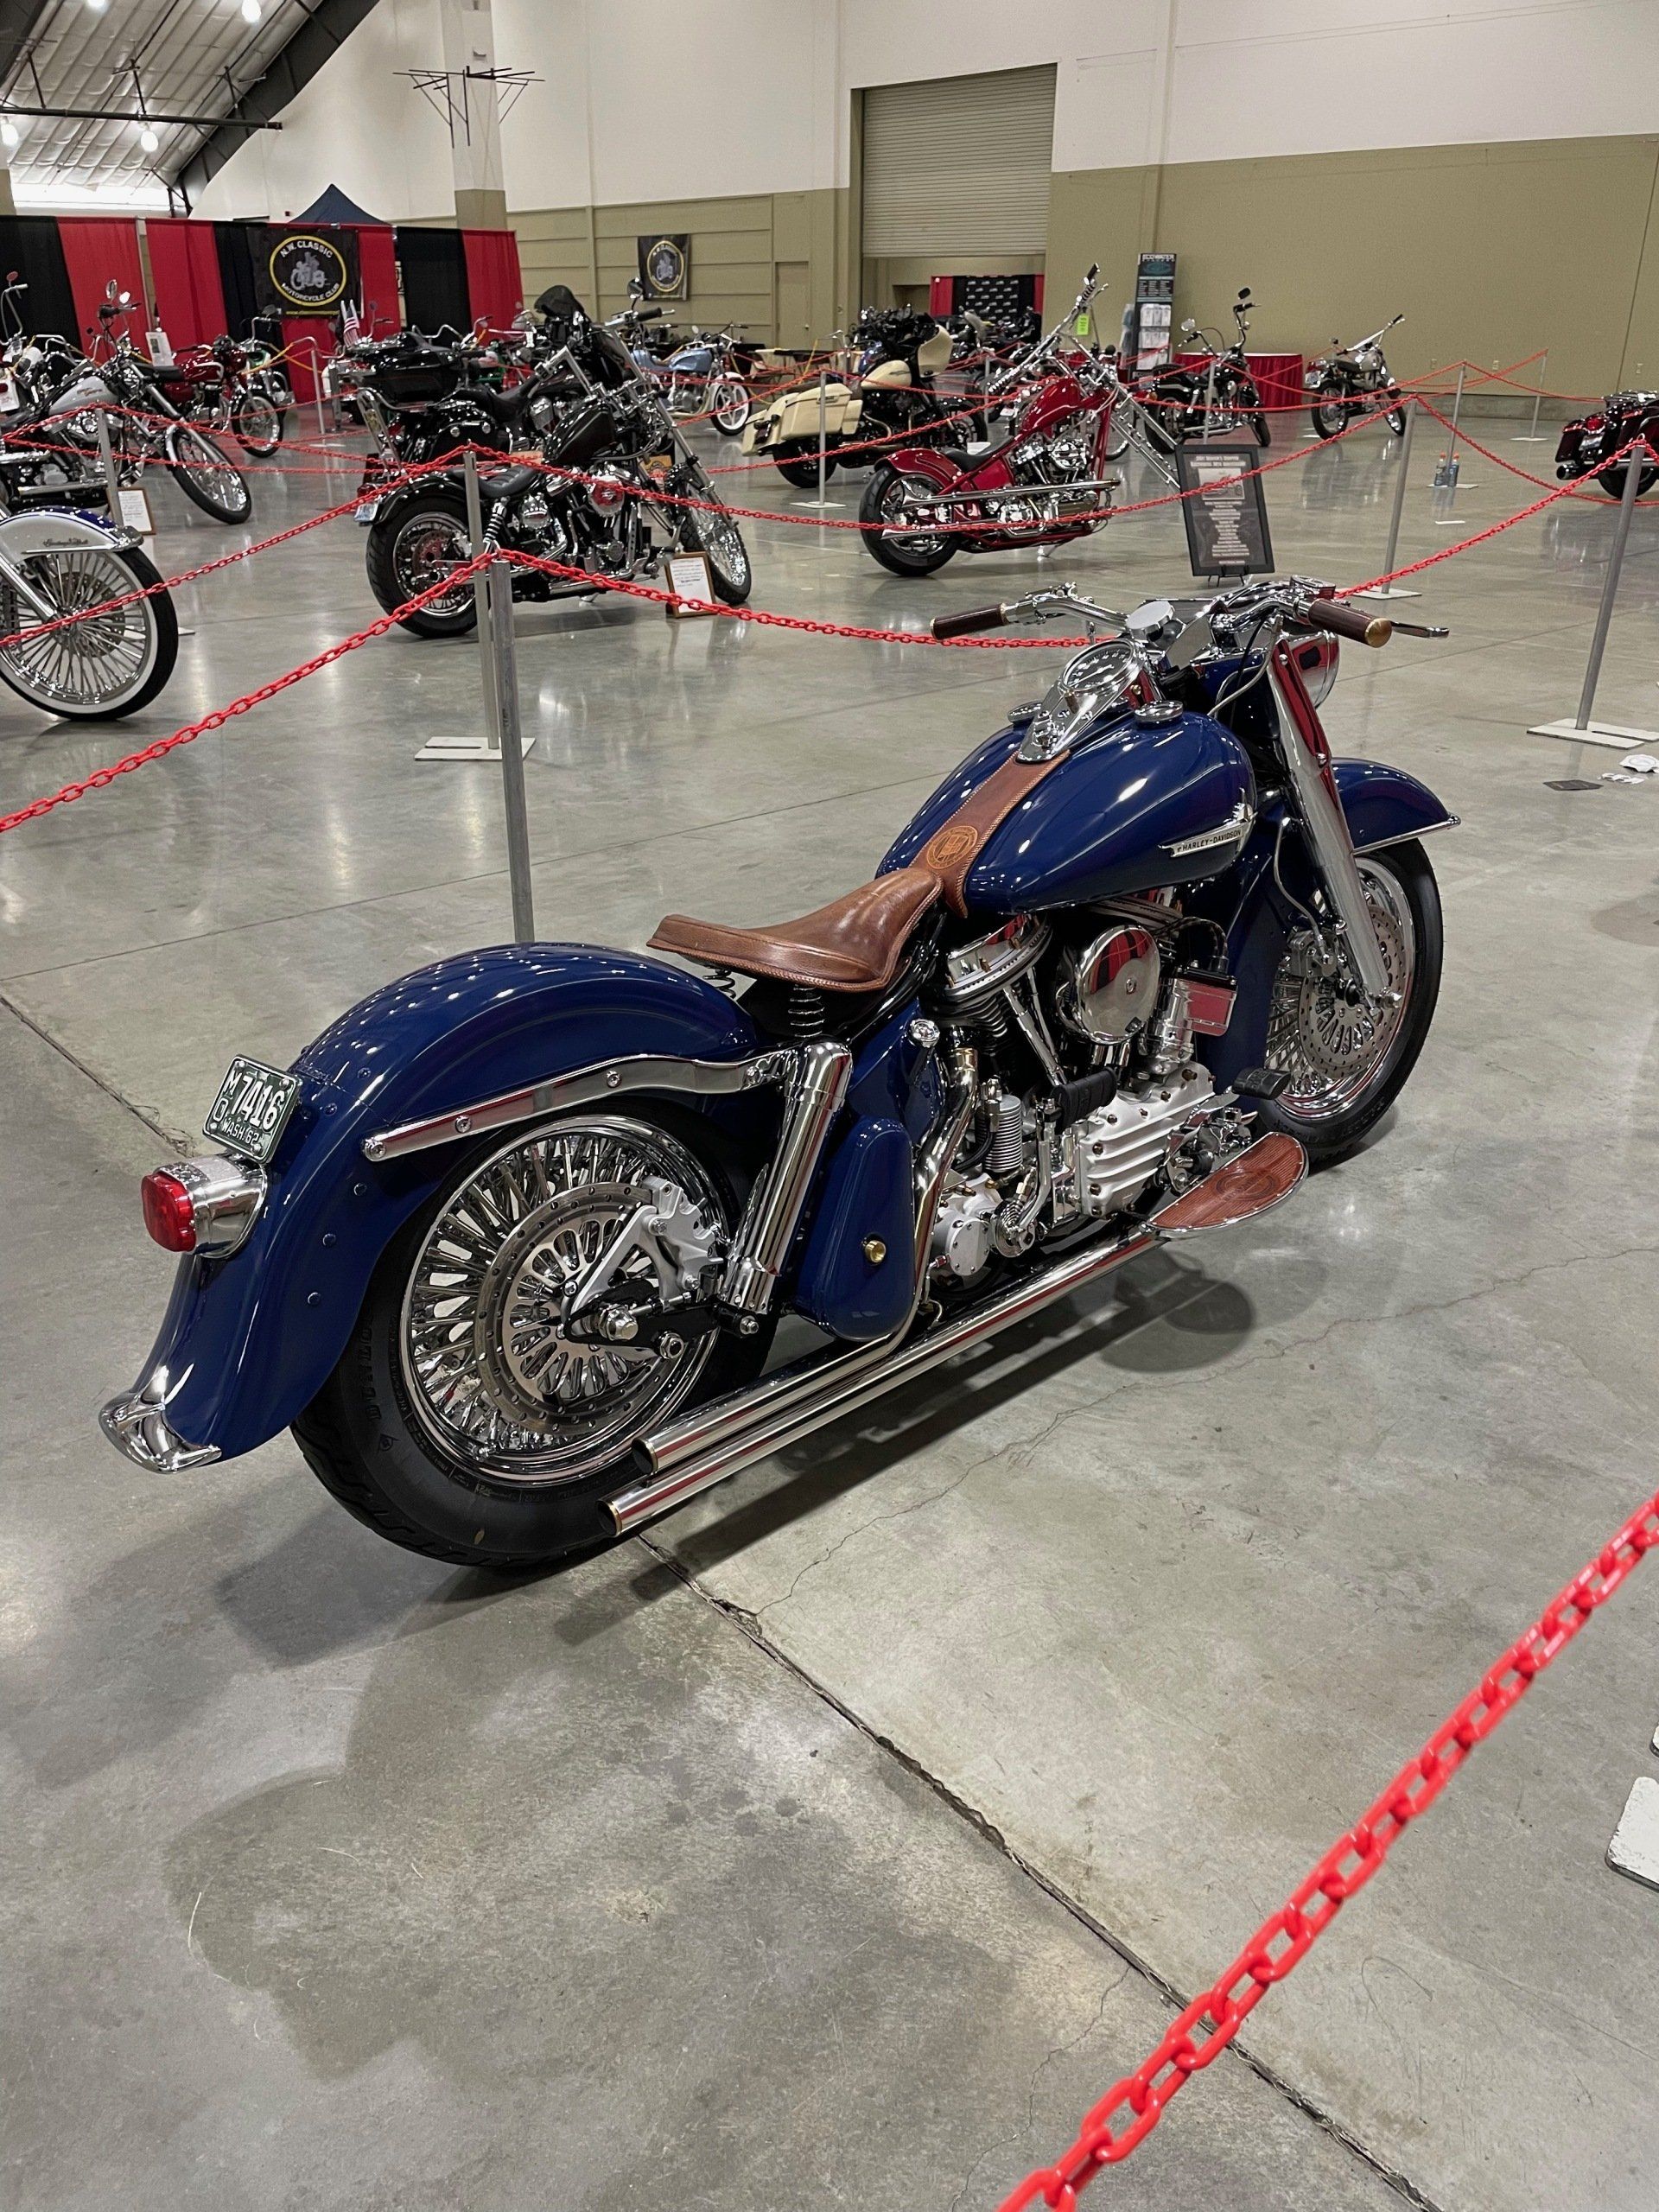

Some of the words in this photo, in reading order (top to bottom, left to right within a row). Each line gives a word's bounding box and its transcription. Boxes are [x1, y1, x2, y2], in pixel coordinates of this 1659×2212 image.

[297, 240, 333, 258] CLASSIC
[1182, 830, 1241, 850] HARLEY-DAVIDSON
[231, 1074, 285, 1130] 7416
